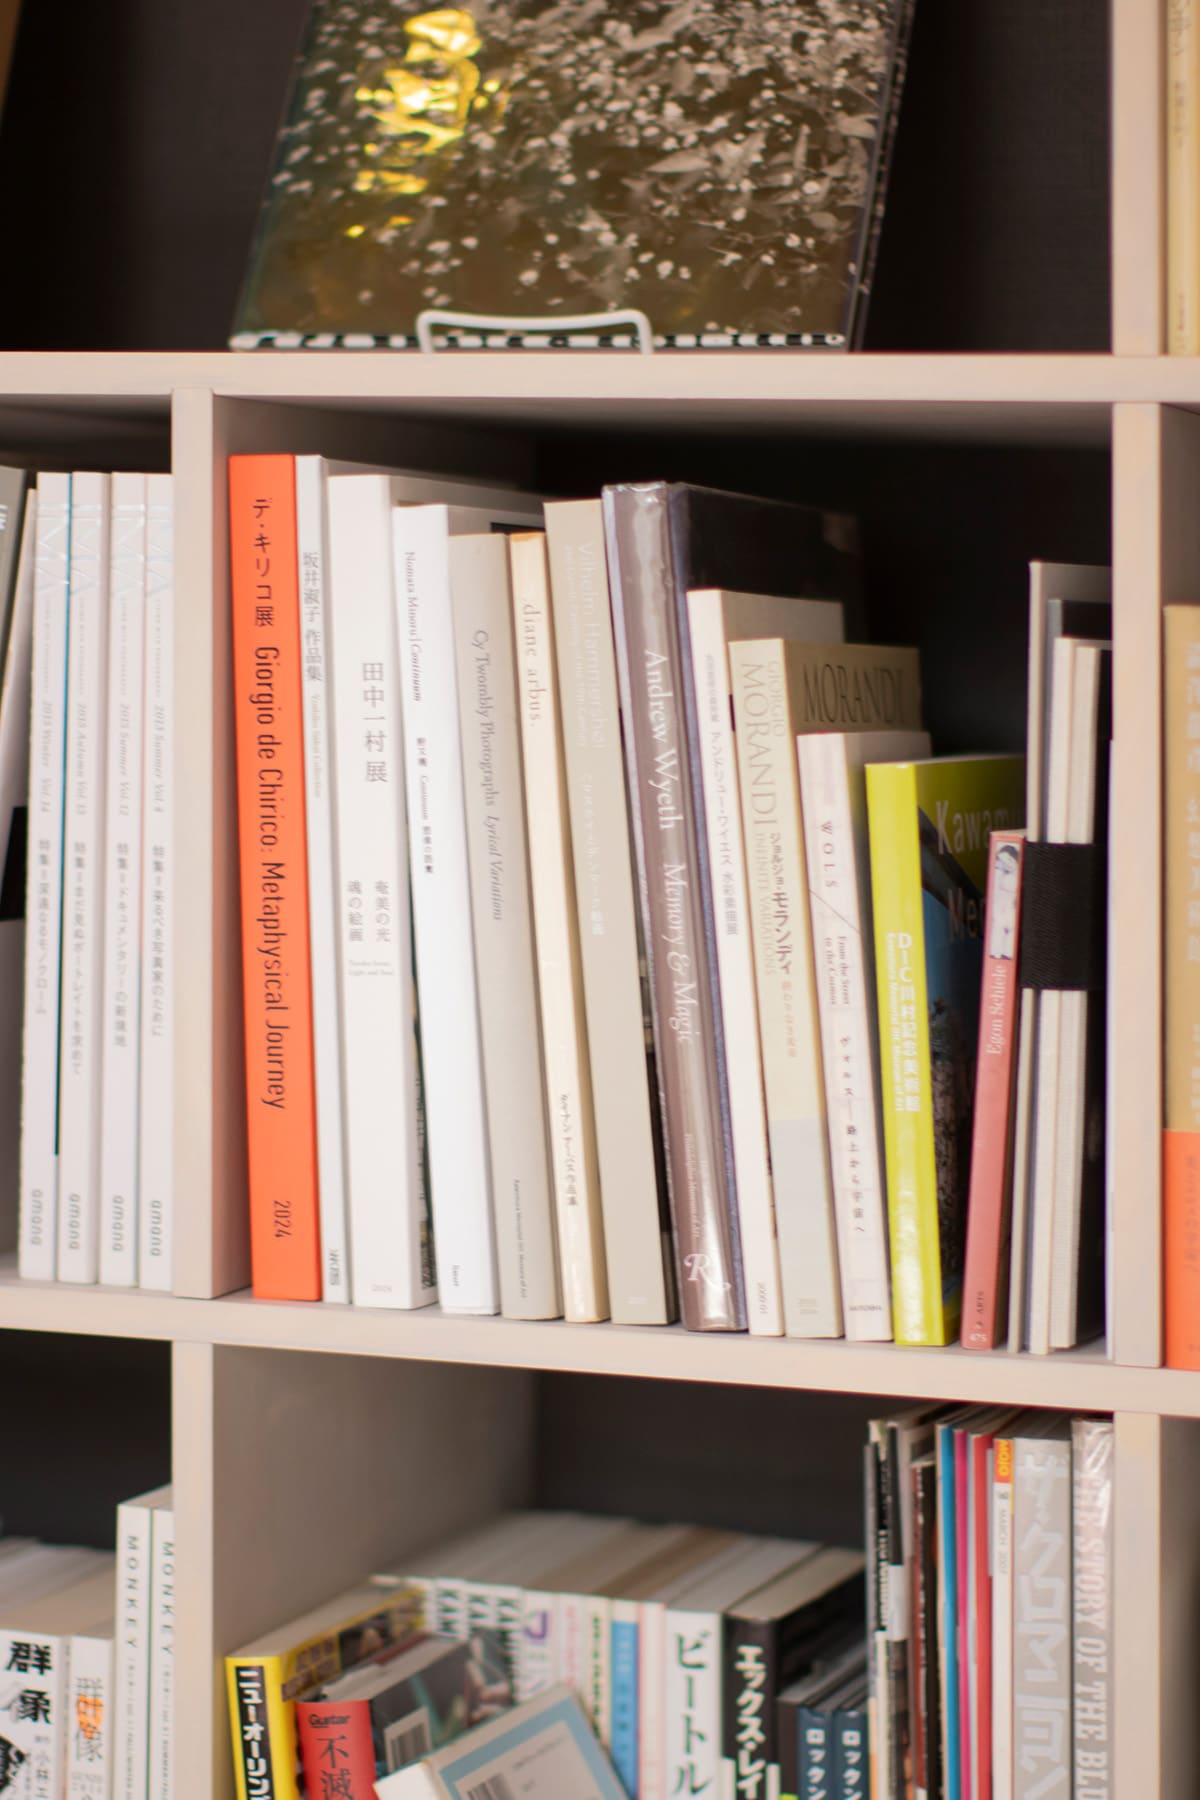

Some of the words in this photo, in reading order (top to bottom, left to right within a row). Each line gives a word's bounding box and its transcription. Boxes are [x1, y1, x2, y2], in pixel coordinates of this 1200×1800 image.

[471, 629, 490, 650] Cy
[522, 603, 543, 657] diane
[249, 646, 282, 725] Giorgio
[475, 652, 494, 718] Twombly
[643, 648, 673, 742] Andrew
[802, 662, 904, 724] MORANDI
[258, 733, 285, 760] de
[362, 661, 388, 783] 田中一村展
[741, 663, 779, 825] MORANDI
[480, 720, 500, 807] Photographs
[650, 747, 685, 831] Wyeth
[485, 815, 502, 856] Lyrical
[819, 820, 839, 889] WOLS
[488, 859, 505, 922] Variations
[661, 862, 688, 945] Memory
[256, 861, 291, 1011] Metaphysical
[671, 979, 700, 1045] Magic
[989, 964, 1008, 1016] Schiele
[261, 1018, 292, 1111] Journey
[985, 1018, 1005, 1056] Egon
[67, 1193, 82, 1251] amana
[111, 1194, 126, 1253] amana
[149, 1199, 163, 1257] amana
[273, 1199, 293, 1239] 2024
[998, 1439, 1010, 1477] MOJO
[126, 1535, 139, 1649] MONKEY
[161, 1540, 175, 1656] MONKEY
[1074, 1535, 1106, 1630] STORY
[1075, 1636, 1107, 1673] OF
[238, 1669, 271, 1800] ニューオーリン
[1075, 1681, 1108, 1741] THE
